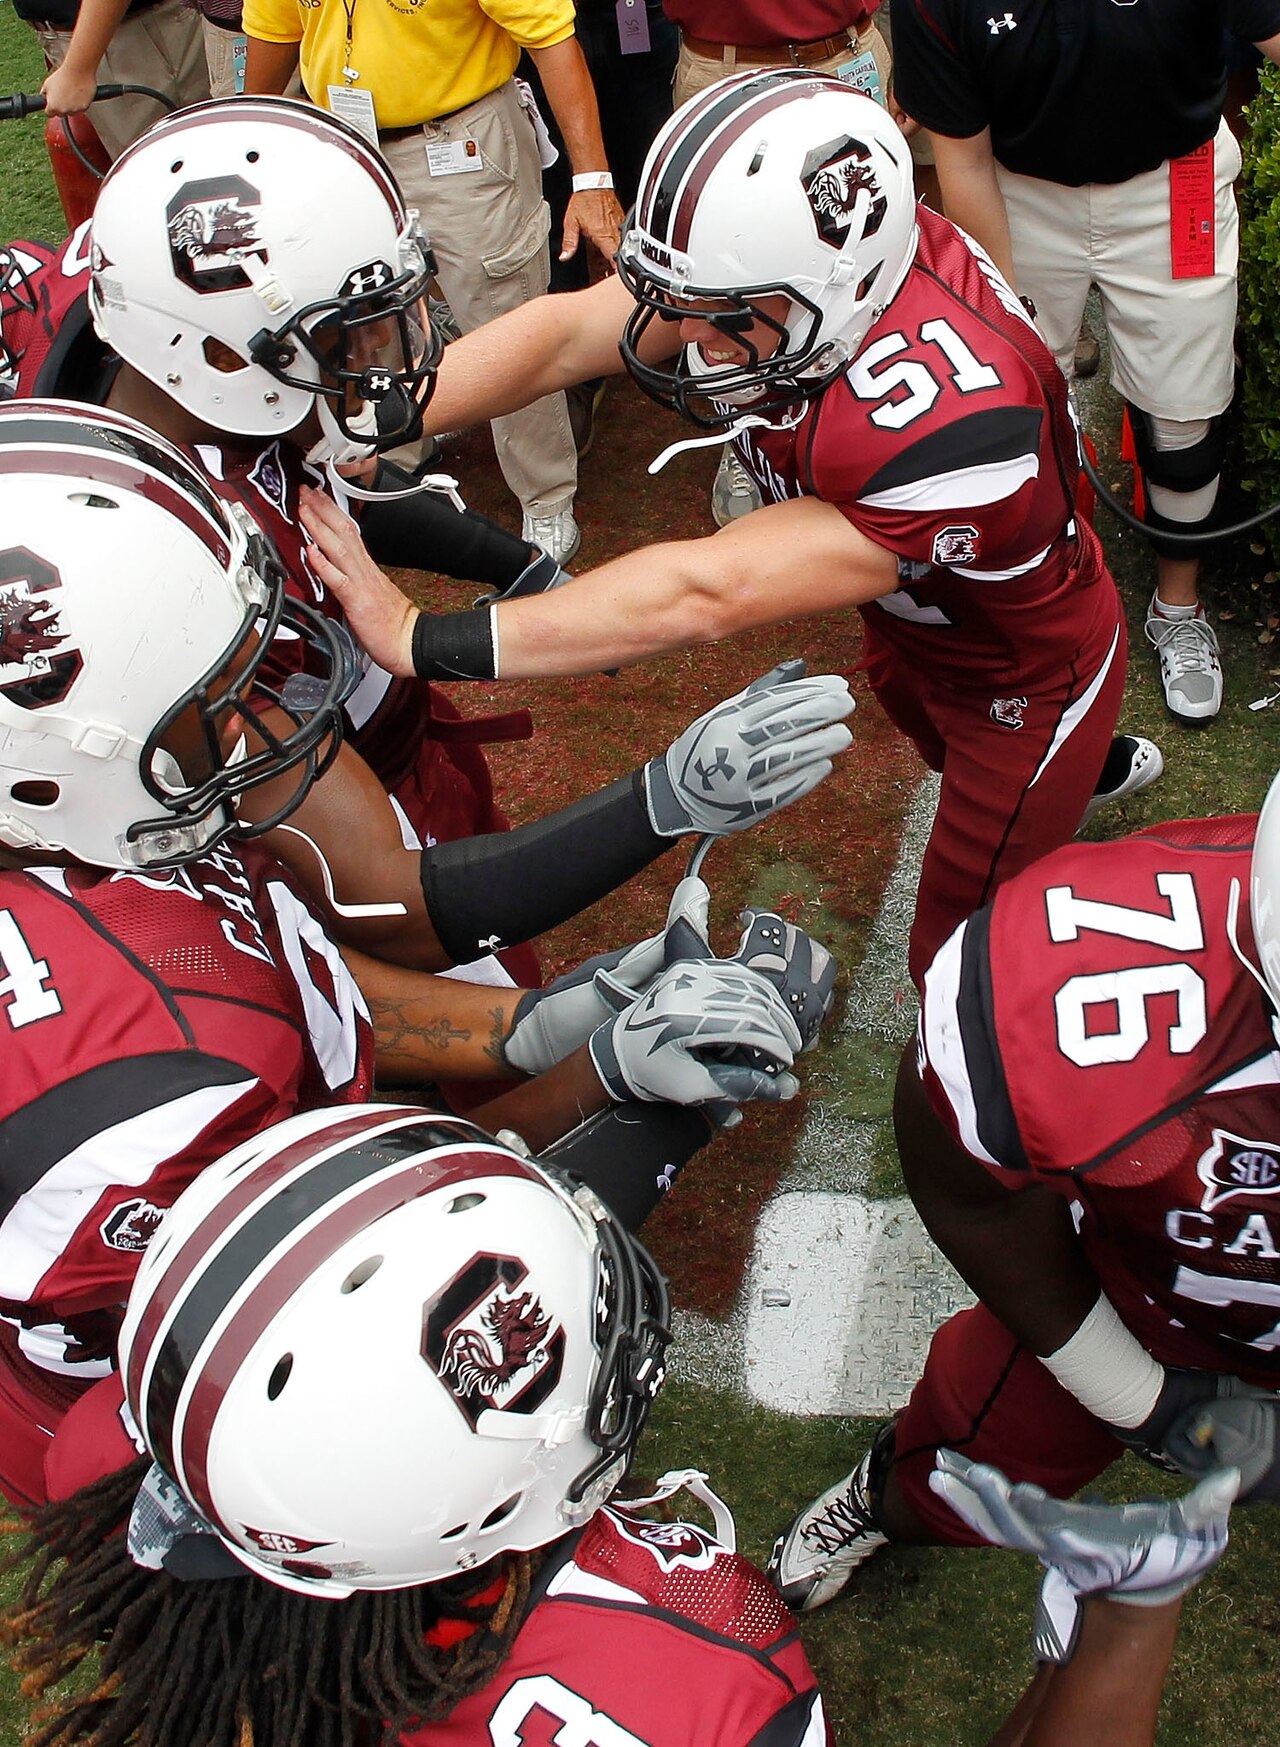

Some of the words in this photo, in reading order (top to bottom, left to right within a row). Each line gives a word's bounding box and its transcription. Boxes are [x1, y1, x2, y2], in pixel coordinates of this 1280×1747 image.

[844, 319, 1001, 432] 51
[1045, 872, 1207, 1068] 76
[1229, 1151, 1279, 1185] SEC
[259, 1533, 298, 1553] SEC
